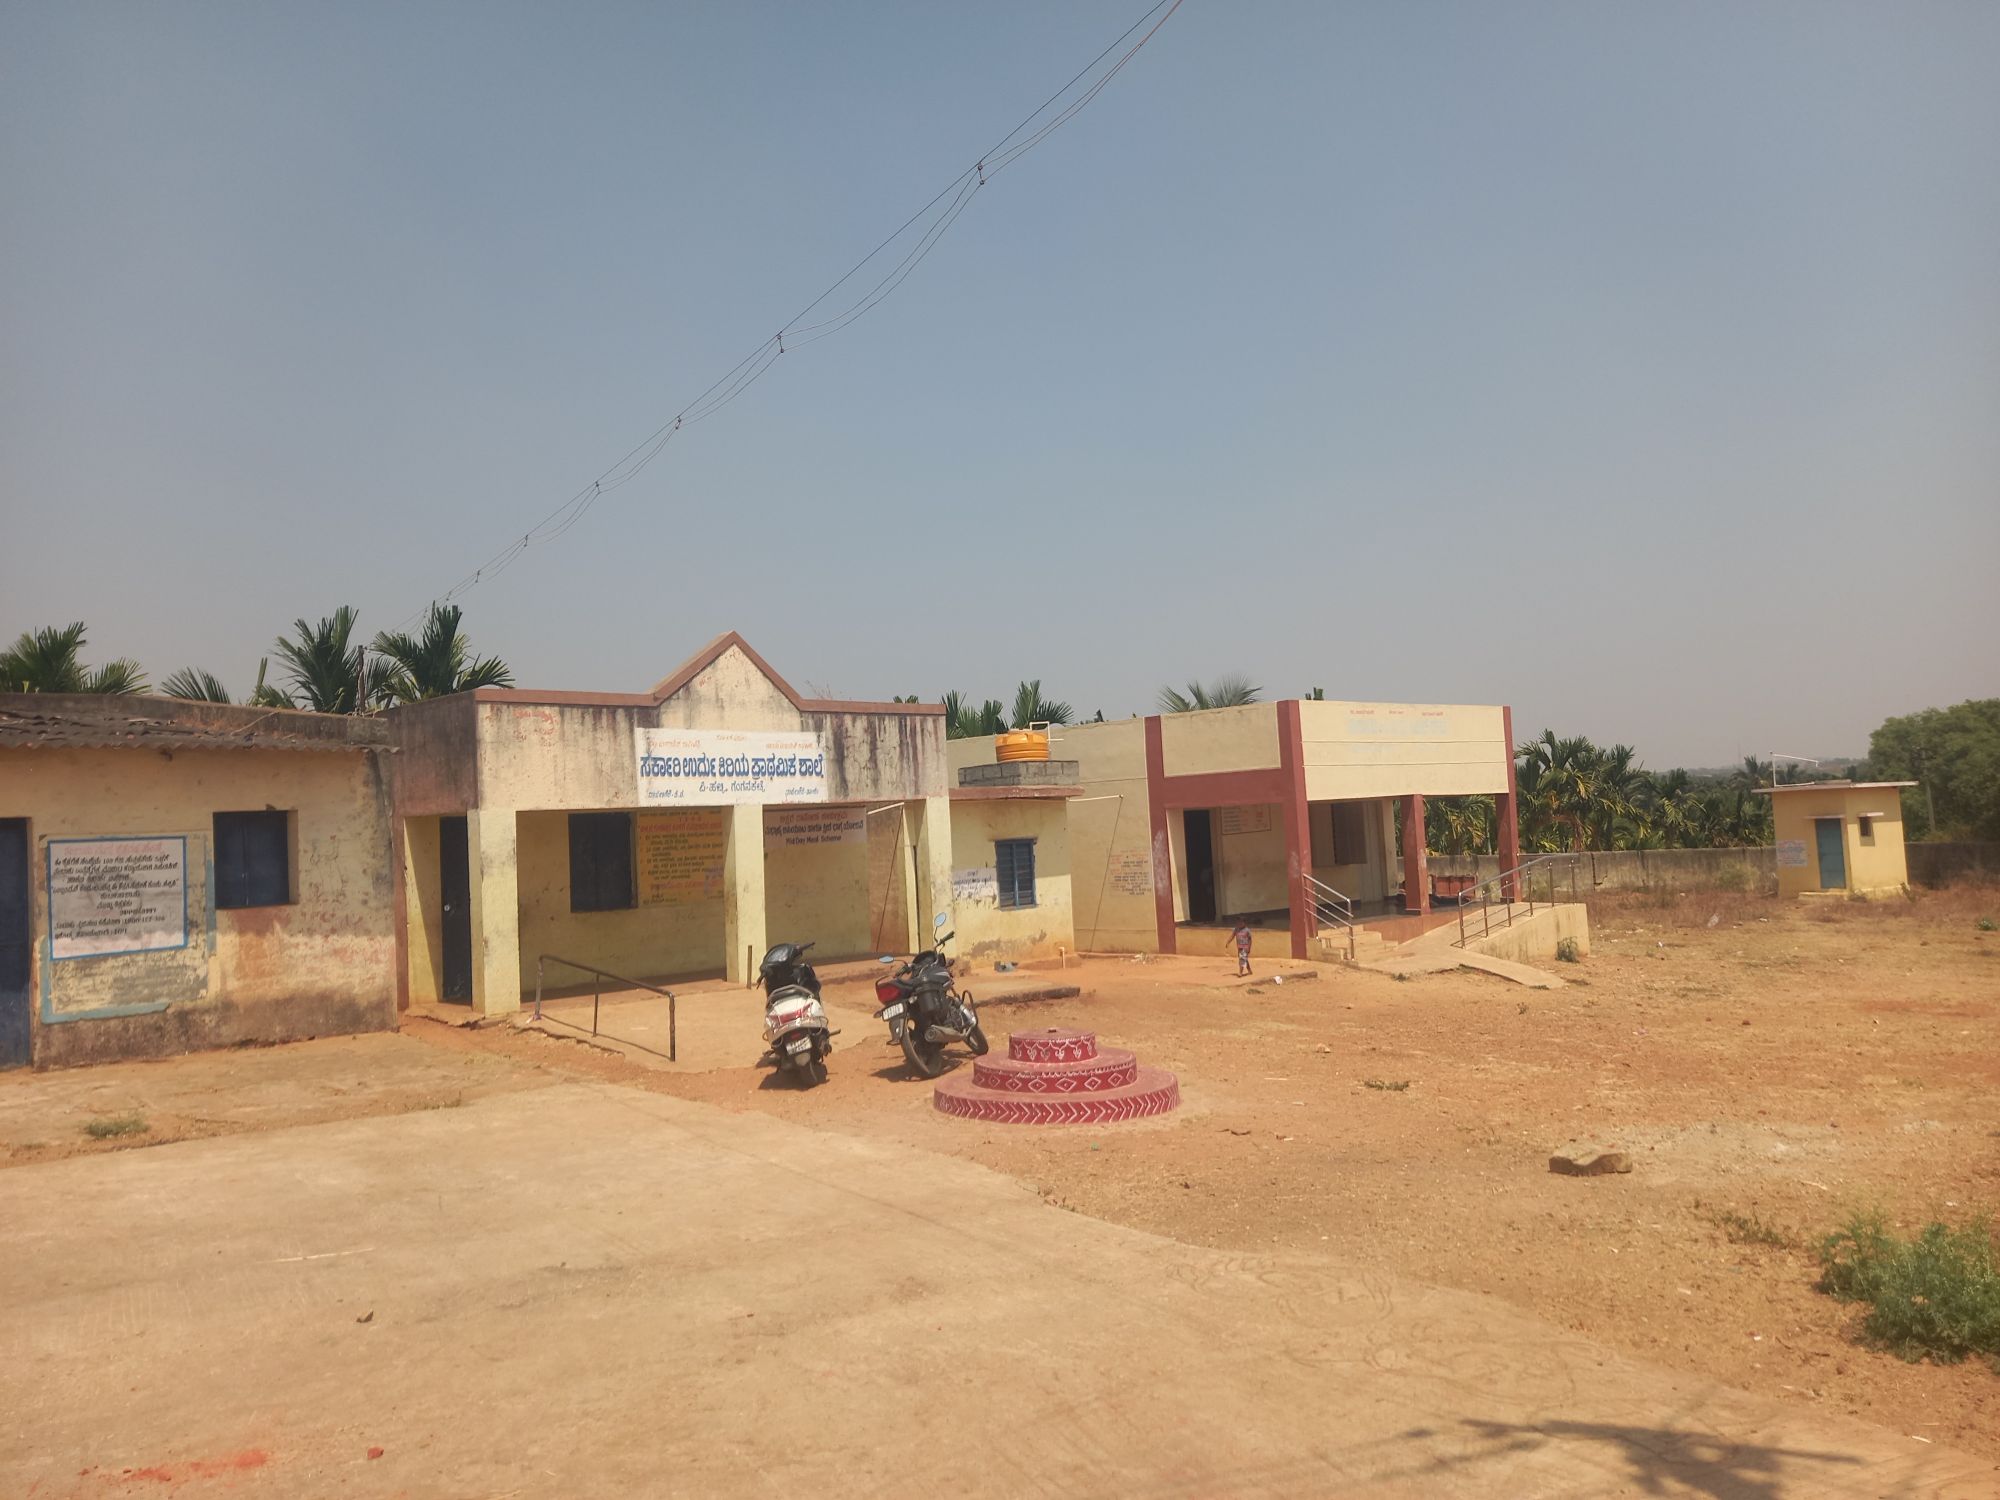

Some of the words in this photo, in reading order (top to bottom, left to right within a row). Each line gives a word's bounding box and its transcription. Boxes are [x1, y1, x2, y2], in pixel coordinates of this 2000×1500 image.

[640, 752, 681, 777] ಸರ್ಕಾರಿ
[683, 752, 716, 777] ಉರ್ದು
[719, 753, 749, 777] ಕಿರಿಯ
[751, 753, 796, 782] ಪ್ರಾಥಮಿಕ
[799, 753, 824, 778] ಶಾಲೆ
[796, 837, 806, 845] Day
[821, 834, 842, 842] Scheme
